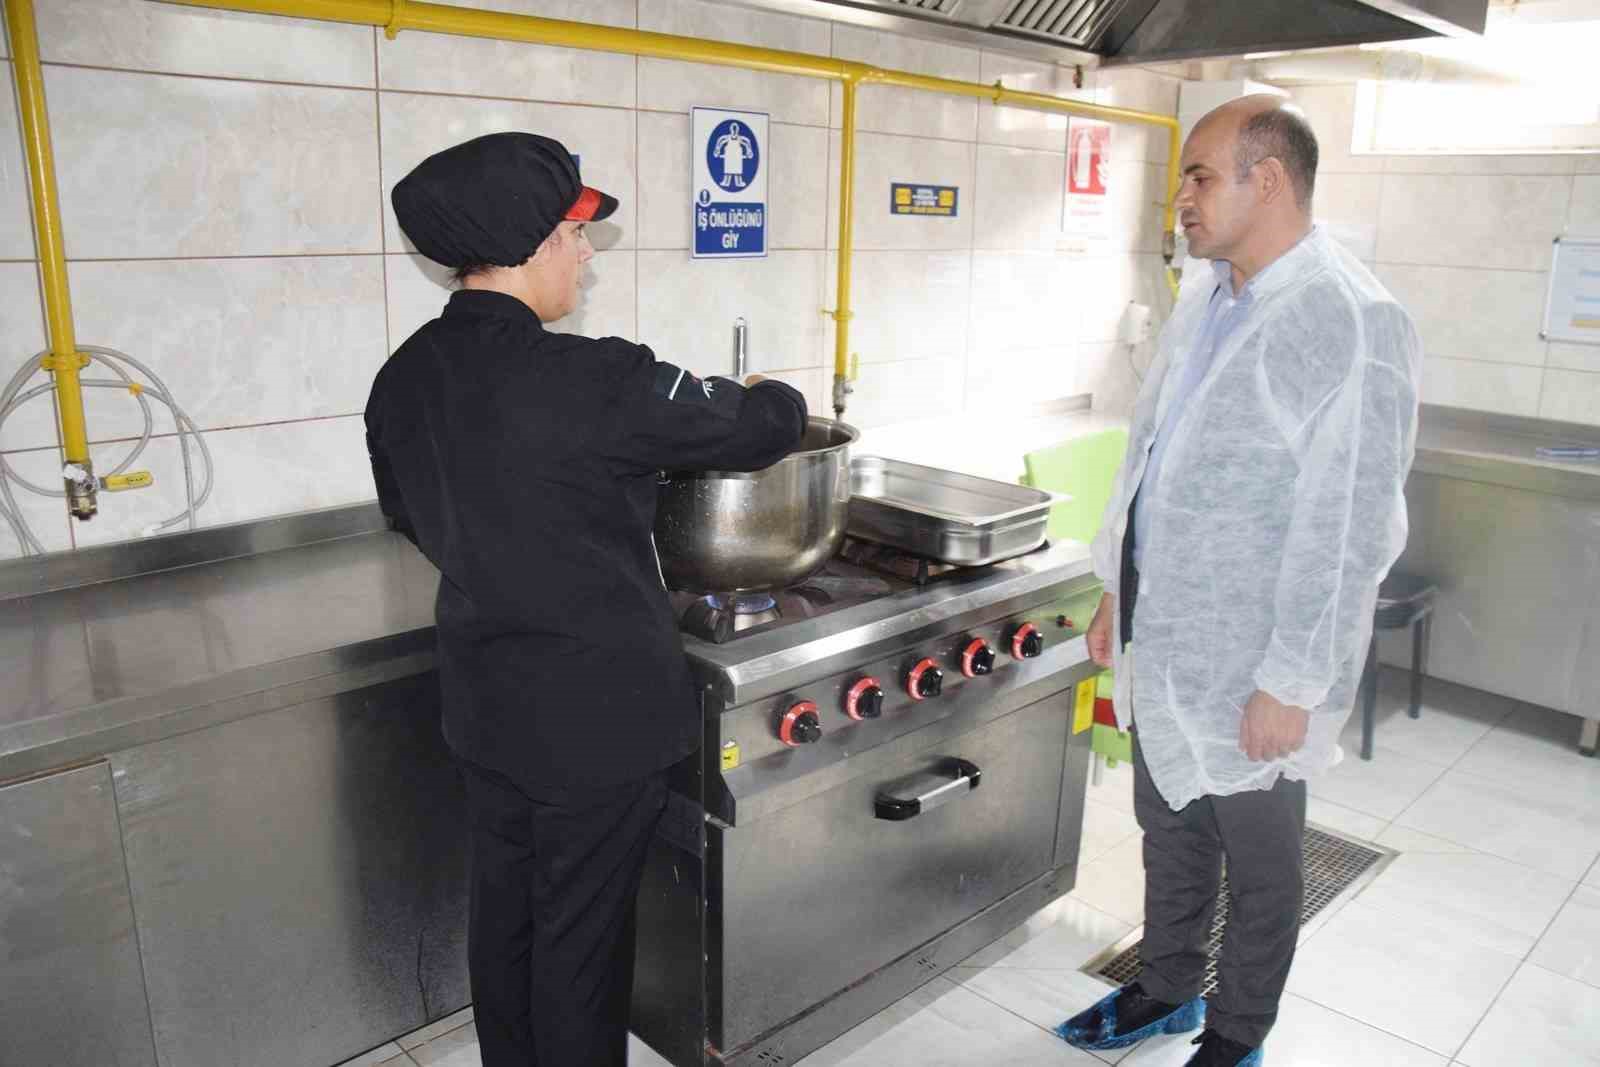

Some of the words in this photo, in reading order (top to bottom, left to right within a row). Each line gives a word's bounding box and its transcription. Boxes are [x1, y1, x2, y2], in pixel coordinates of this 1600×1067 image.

[697, 208, 708, 231] İŞ
[710, 208, 762, 228] ÖNLÜĞÜNÜ
[722, 230, 740, 249] GİY
